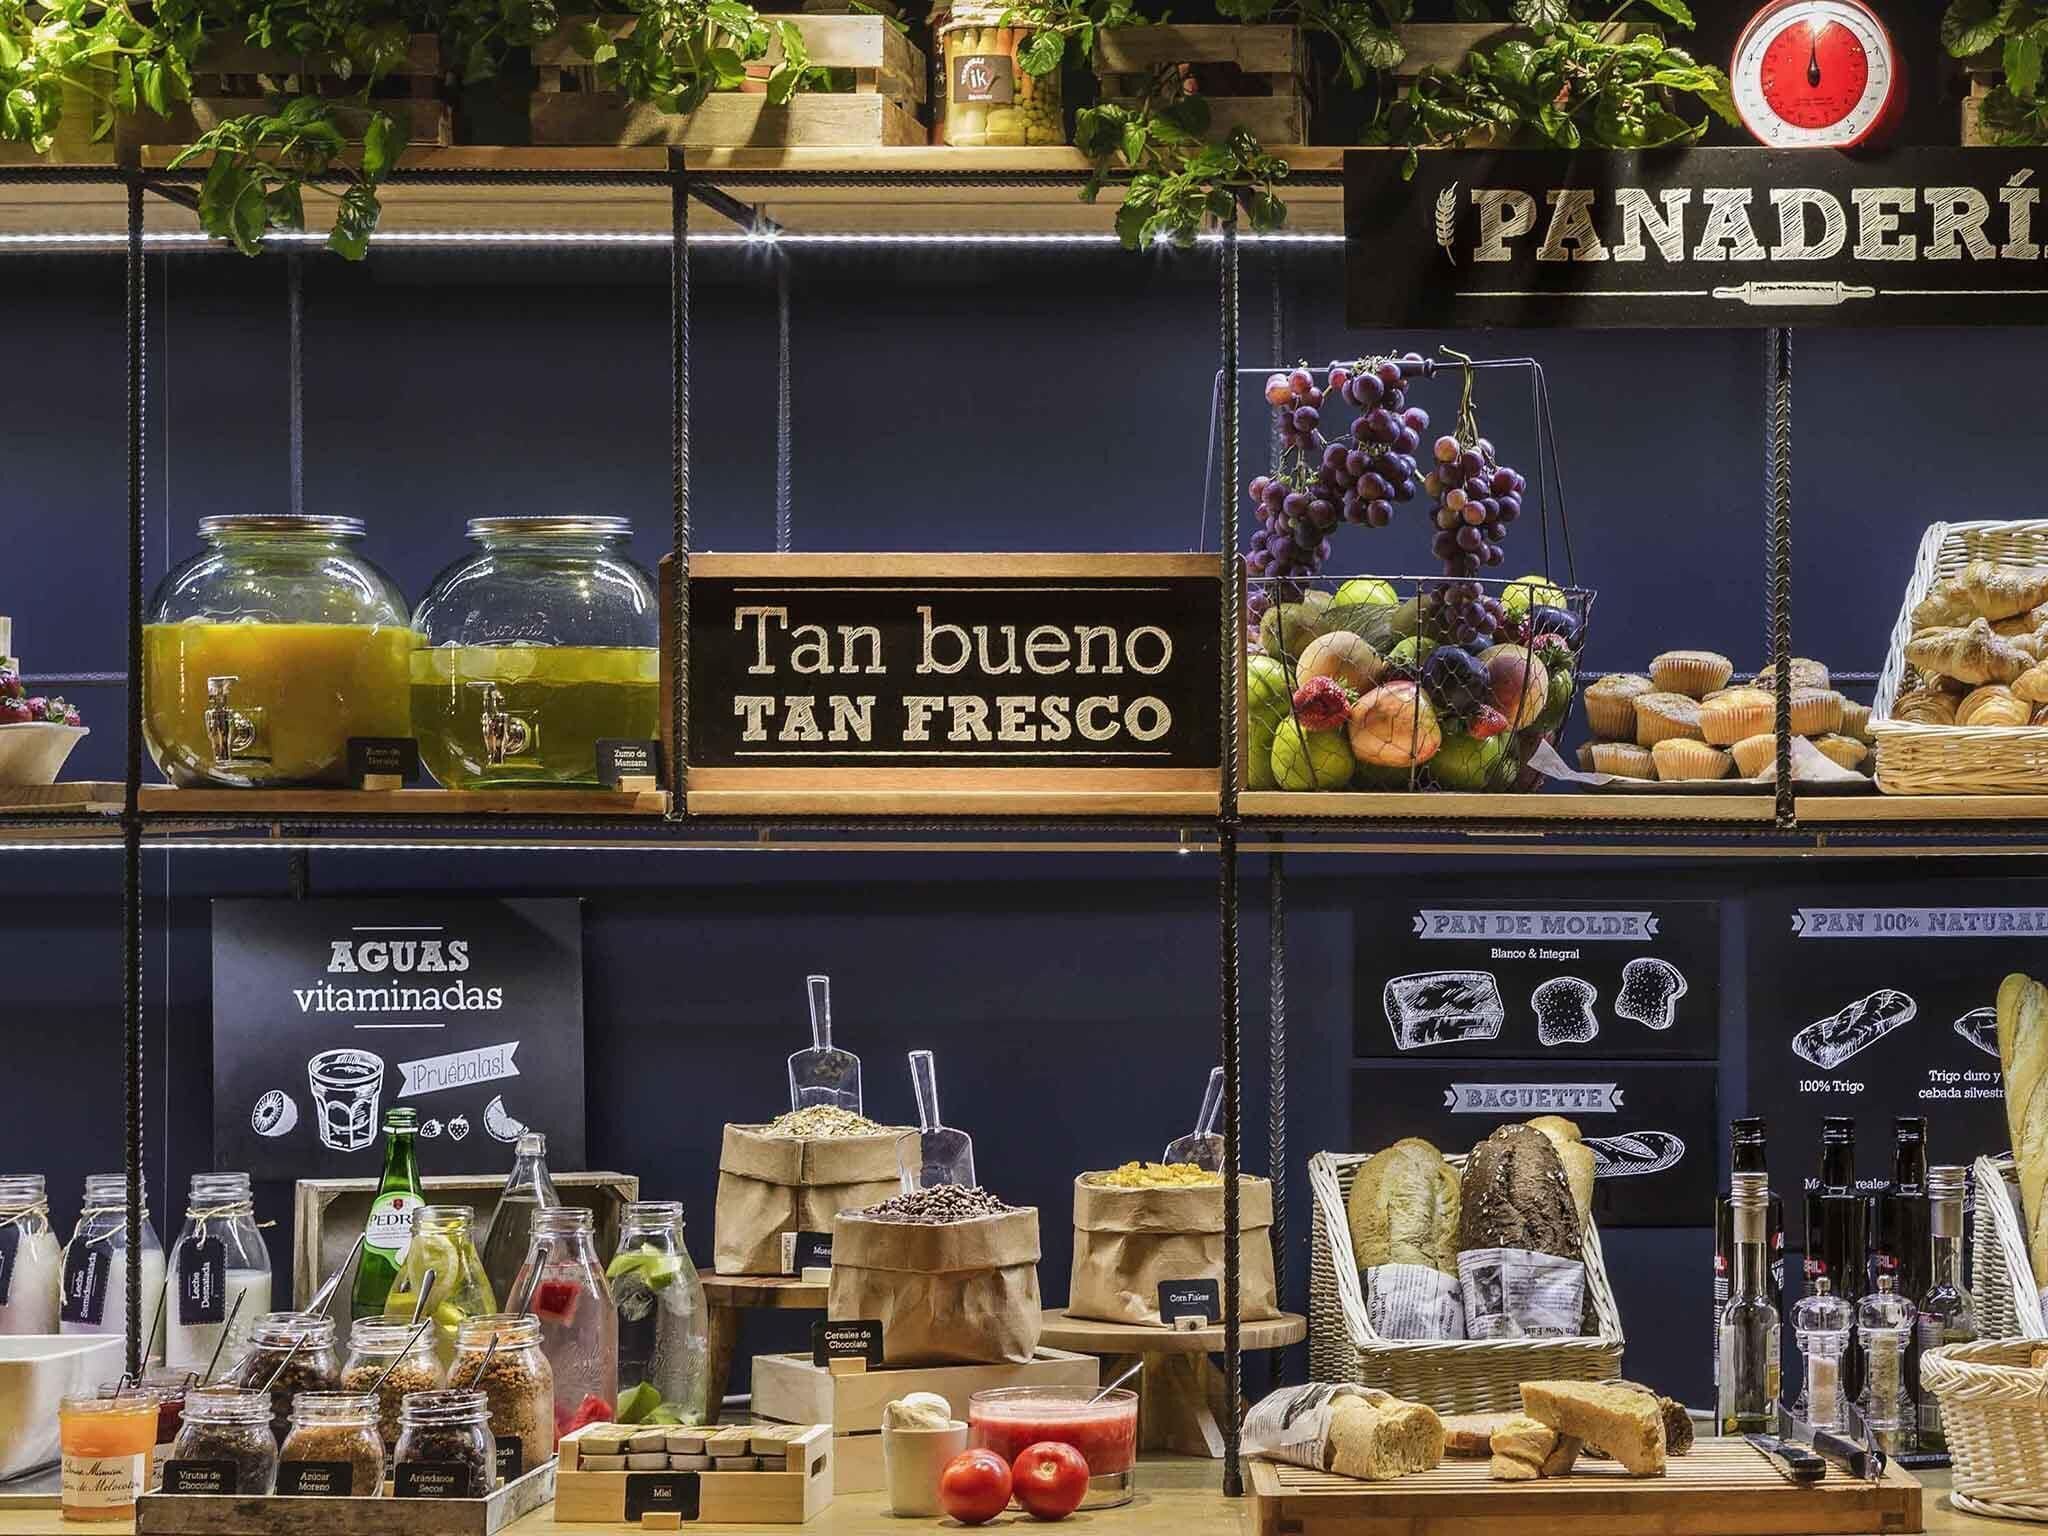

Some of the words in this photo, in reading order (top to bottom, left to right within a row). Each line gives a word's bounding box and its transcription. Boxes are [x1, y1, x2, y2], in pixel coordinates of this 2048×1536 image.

[1471, 168, 2048, 262] PANADERÍ
[735, 606, 886, 674] Tan
[917, 606, 1173, 674] bueno
[735, 695, 876, 742] TAN
[903, 695, 1172, 742] FRESCO
[614, 749, 635, 758] Zumo
[636, 749, 647, 758] de
[1433, 914, 1487, 935] PAN
[1495, 915, 1532, 935] DE
[1540, 915, 1639, 936] MOLDE
[1811, 912, 1865, 932] PAN
[1873, 912, 1920, 932] 100%
[1928, 912, 2048, 932] NATURAL
[327, 940, 470, 973] AGUAS
[1491, 948, 1526, 960] Blanco
[1528, 948, 1537, 960] &
[1539, 948, 1580, 962] Integral
[293, 979, 503, 1012] vitaminadas
[412, 1049, 506, 1091] ¡Pruébalas!
[1928, 1069, 1961, 1084] Trigo
[1963, 1069, 1990, 1082] duro
[1992, 1072, 2001, 1084] y
[1799, 1080, 1830, 1092] 100%
[1832, 1080, 1864, 1095] Trigo
[1919, 1087, 1962, 1099] cebada
[1964, 1087, 2006, 1099] silvestr
[1465, 1089, 1602, 1107] BAGUETTE
[73, 1270, 85, 1298] Leche
[192, 1271, 201, 1299] Leche
[201, 1261, 211, 1309] Desnatada
[1169, 1294, 1187, 1303] Corn
[825, 1330, 859, 1340] Cereales
[861, 1330, 871, 1339] de
[829, 1341, 868, 1350] Chocolate
[179, 1471, 209, 1481] Virutas
[210, 1471, 221, 1480] de
[178, 1481, 220, 1491] Chocolate
[298, 1482, 330, 1492] Moreno
[418, 1484, 444, 1493] Secos
[653, 1488, 672, 1497] Miel
